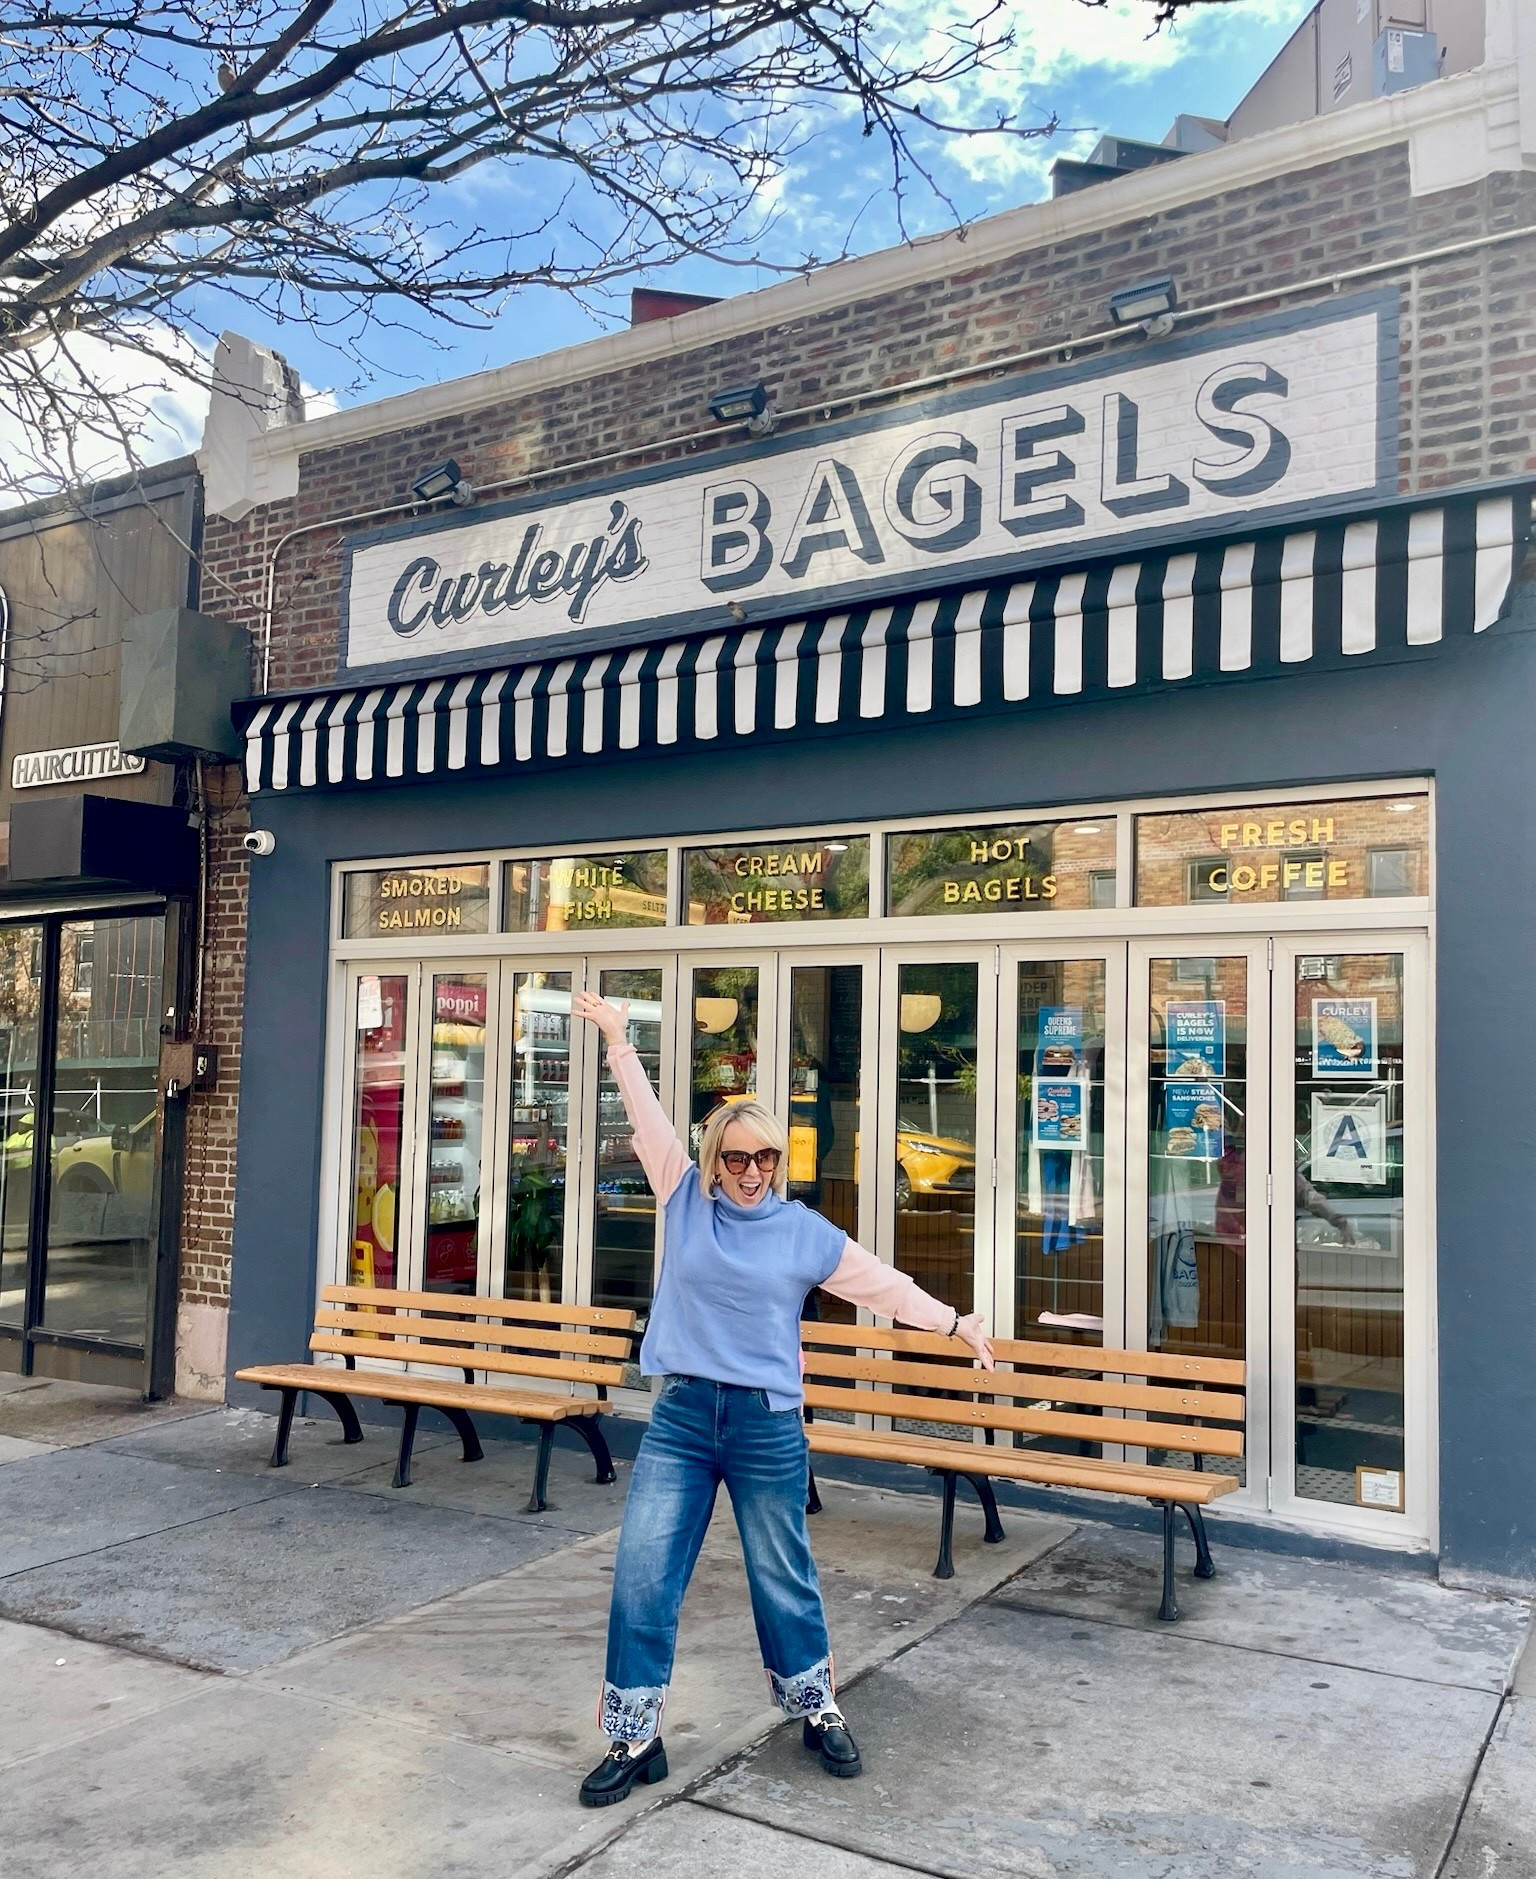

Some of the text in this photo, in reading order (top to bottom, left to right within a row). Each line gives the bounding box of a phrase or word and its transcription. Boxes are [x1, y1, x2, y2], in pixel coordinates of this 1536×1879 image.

[387, 361, 1291, 638] Curley's BAGELS
[1220, 818, 1335, 849] FRESH
[970, 838, 1031, 864] HOT
[735, 852, 823, 878] CREAM
[1208, 860, 1349, 892] COFFEE
[381, 877, 463, 898] SMOKED
[553, 866, 624, 889] WHITE
[731, 888, 825, 913] CHEESE
[944, 875, 1059, 904] BAGELS
[379, 906, 462, 929] SALMON
[564, 901, 613, 920] FISH
[1020, 982, 1048, 993] DER
[436, 995, 480, 1016] poppi
[1322, 1007, 1369, 1016] CURLEY
[1044, 1025, 1077, 1035] SUPREME
[1047, 1016, 1073, 1026] QUEENS
[1176, 1019, 1215, 1027] BAGELS
[1326, 1115, 1368, 1158] A
